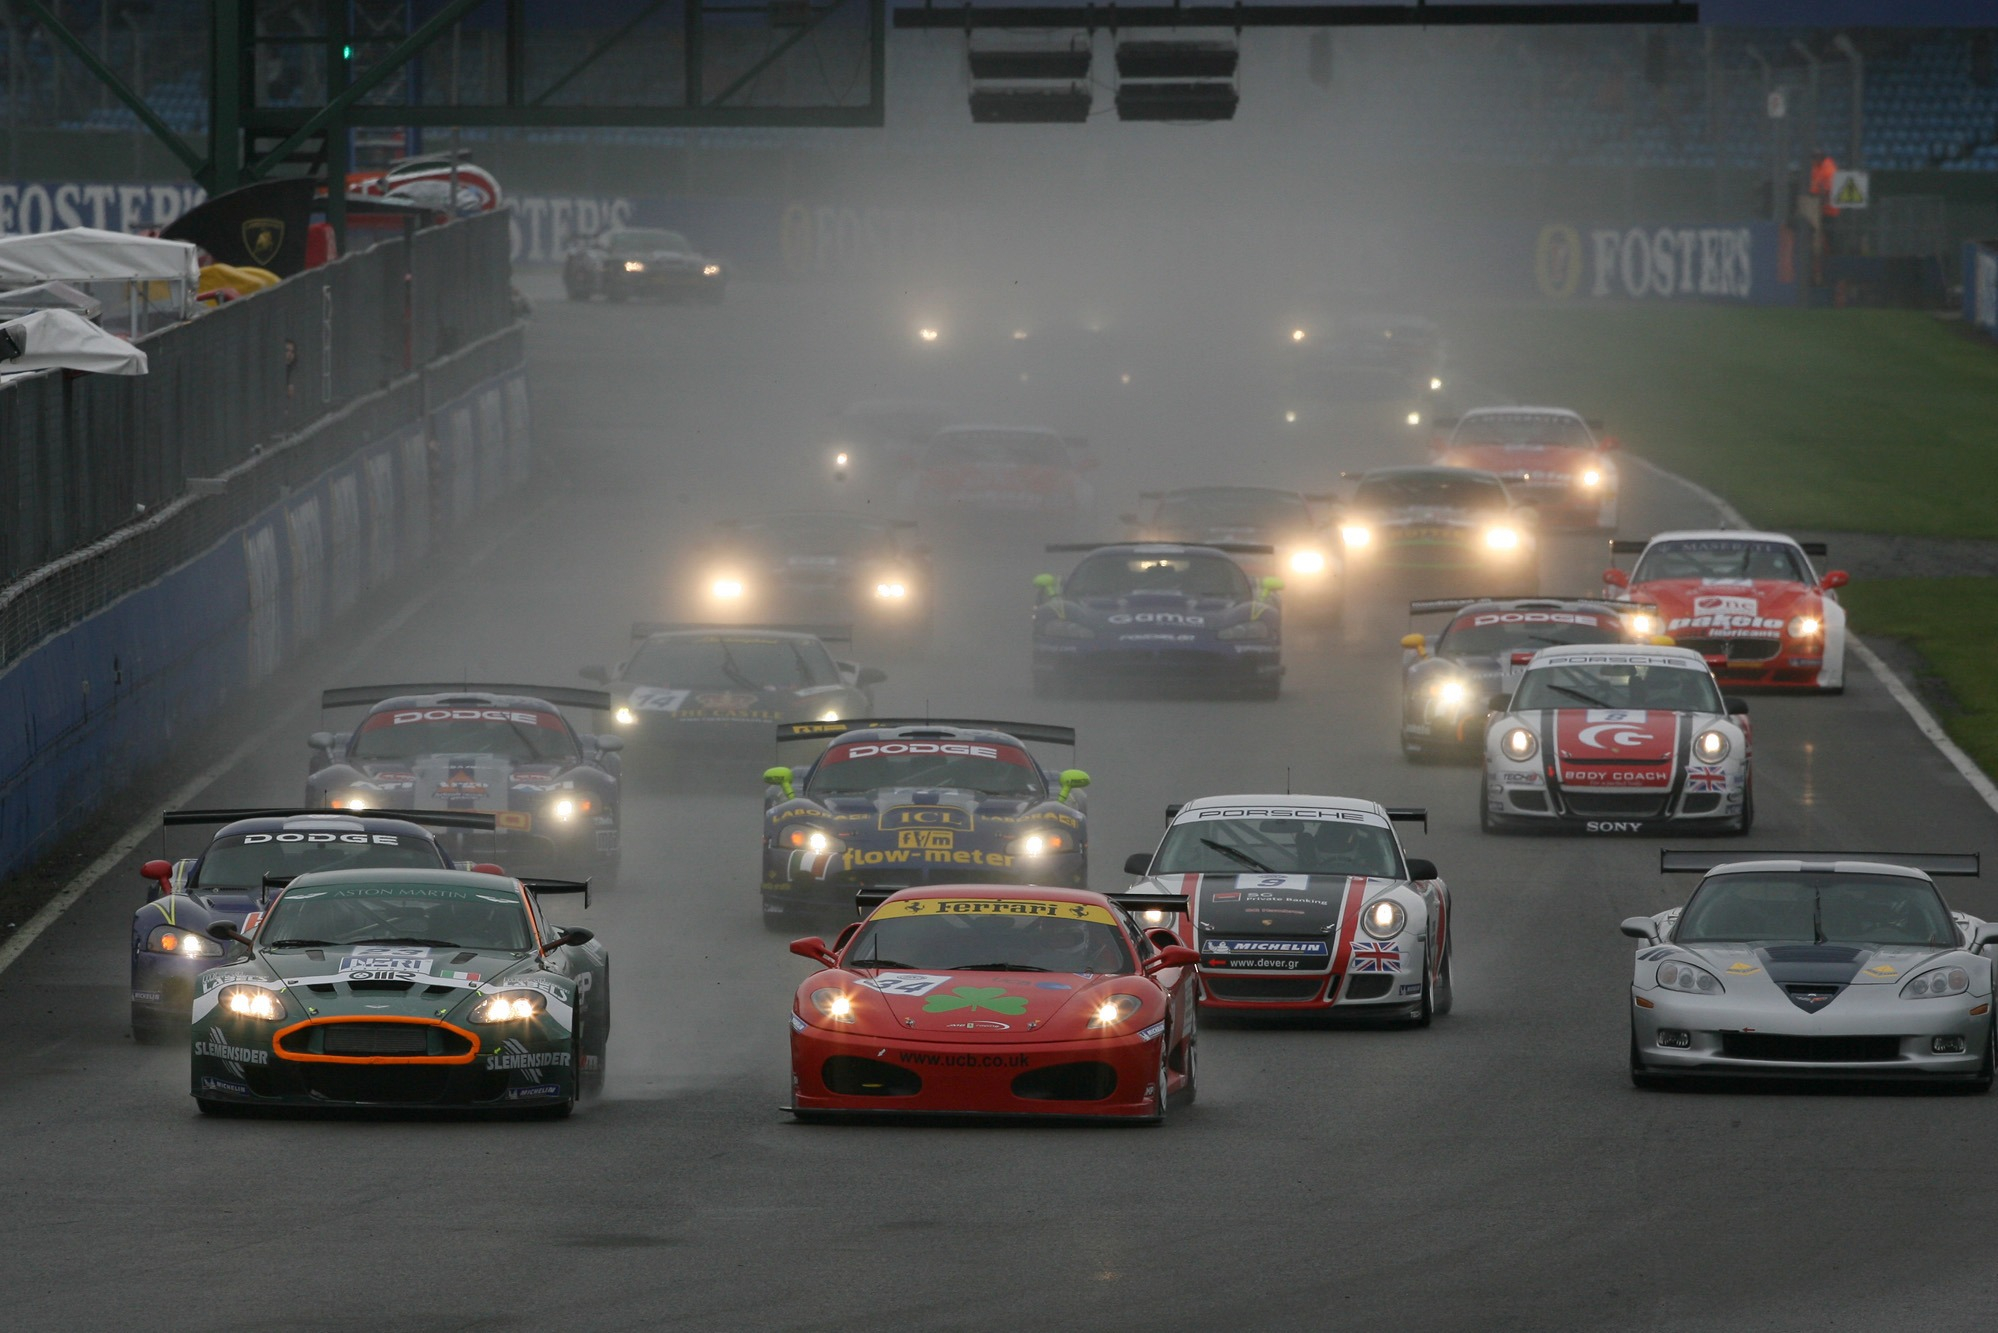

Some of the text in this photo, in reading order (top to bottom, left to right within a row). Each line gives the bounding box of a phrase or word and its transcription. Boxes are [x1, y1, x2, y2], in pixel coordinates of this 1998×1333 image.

[1475, 612, 1598, 628] DODGE
[1549, 657, 1687, 667] PORSCHE
[394, 709, 537, 725] DODGE
[712, 708, 785, 720] CASTLE
[849, 743, 998, 759] DODGE
[1565, 771, 1667, 781] BODY COACH
[901, 811, 963, 826] ICL
[1200, 809, 1365, 822] PORSCHE
[1586, 821, 1643, 833] SONY
[244, 832, 399, 846] DODGE
[842, 847, 1016, 871] flow-meter
[334, 888, 467, 899] ASTON MARTIN
[936, 900, 1057, 916] Ferrari
[1285, 897, 1328, 906] Banking
[1233, 942, 1321, 952] MICHELIN
[1230, 958, 1299, 970] www.dever.gr
[195, 1041, 268, 1065] SLEMENSIDER
[900, 1051, 1029, 1068] www.ucb.co.uk
[486, 1052, 571, 1071] SLEMENSIDER
[519, 1086, 557, 1097] MICHELIN
